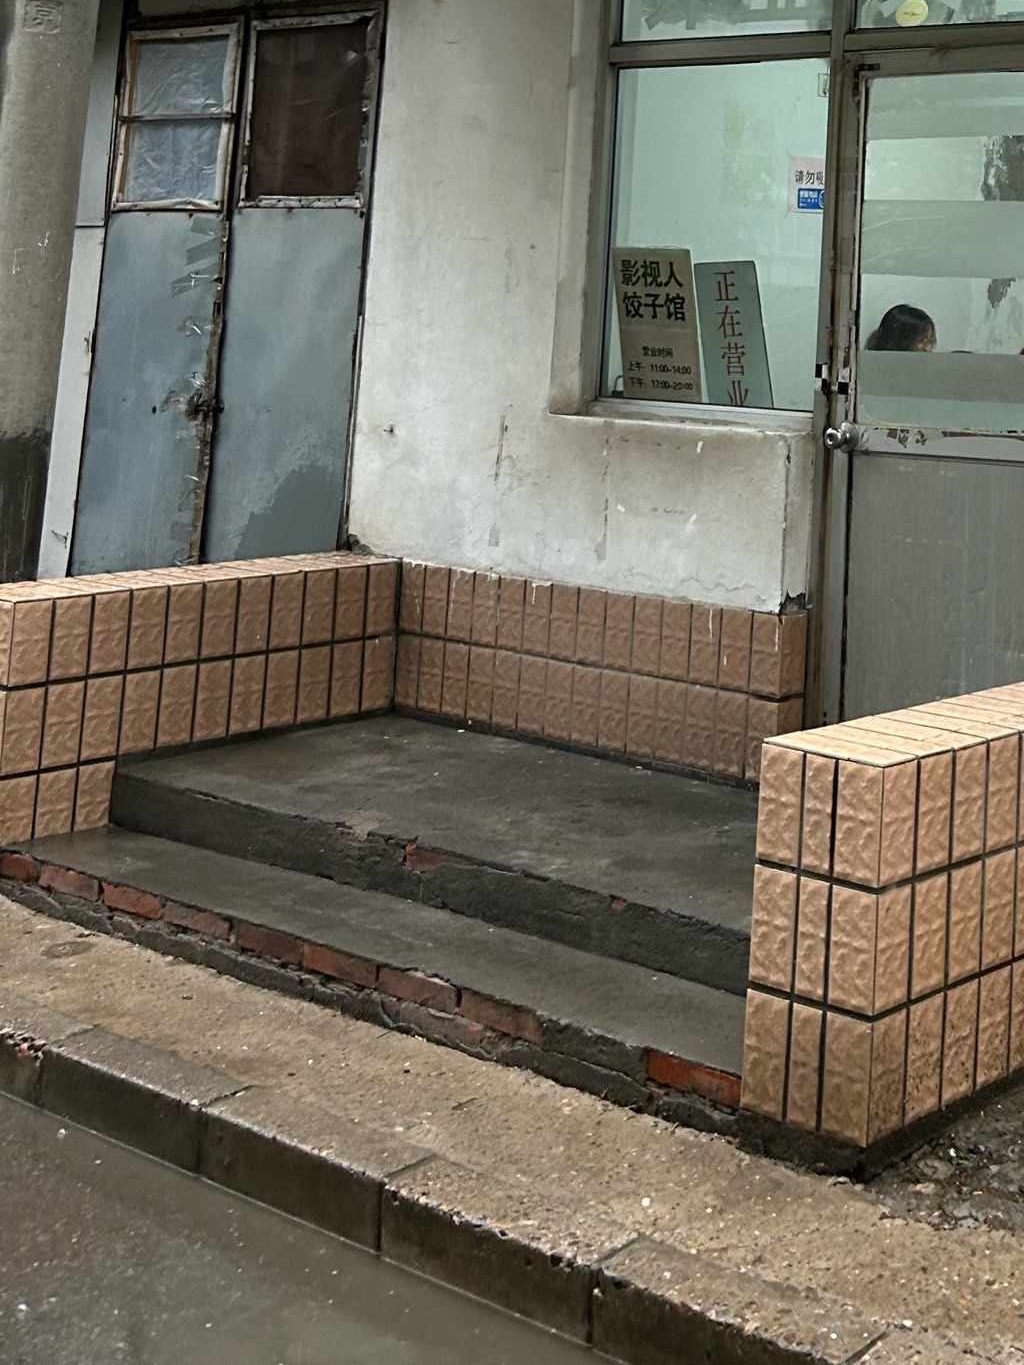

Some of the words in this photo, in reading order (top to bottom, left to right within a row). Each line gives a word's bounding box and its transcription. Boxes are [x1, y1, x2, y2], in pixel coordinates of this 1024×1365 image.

[620, 259, 684, 288] 影视人
[622, 291, 686, 322] 饺子馆
[642, 345, 674, 358] 营业时间
[713, 269, 749, 407] 正在营业
[650, 363, 692, 375] 11:00-14:00
